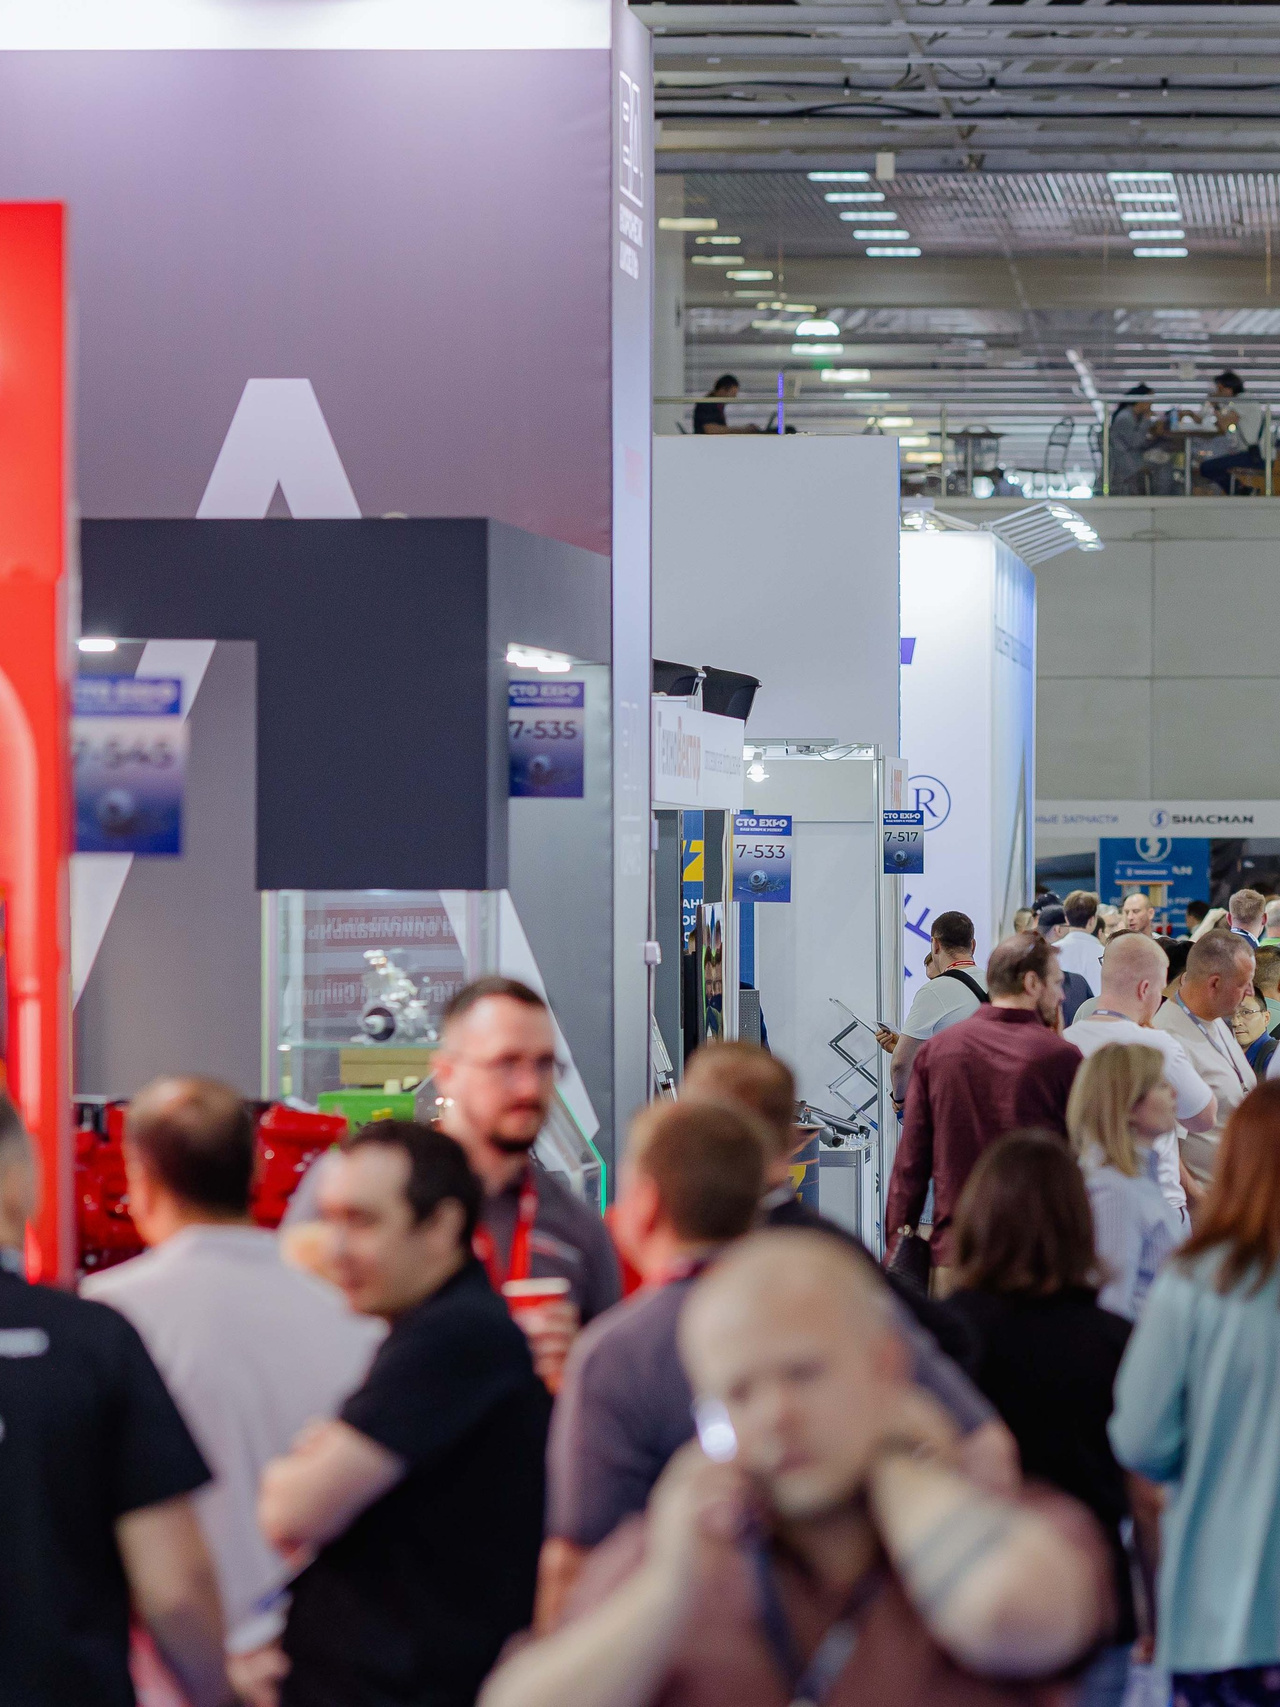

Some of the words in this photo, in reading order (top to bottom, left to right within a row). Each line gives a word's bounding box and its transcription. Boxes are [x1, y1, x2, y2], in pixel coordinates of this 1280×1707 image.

[508, 720, 577, 740] 7-535
[1172, 815, 1254, 824] SHACMAN
[884, 831, 919, 842] 7-517
[736, 844, 785, 859] 7-533
